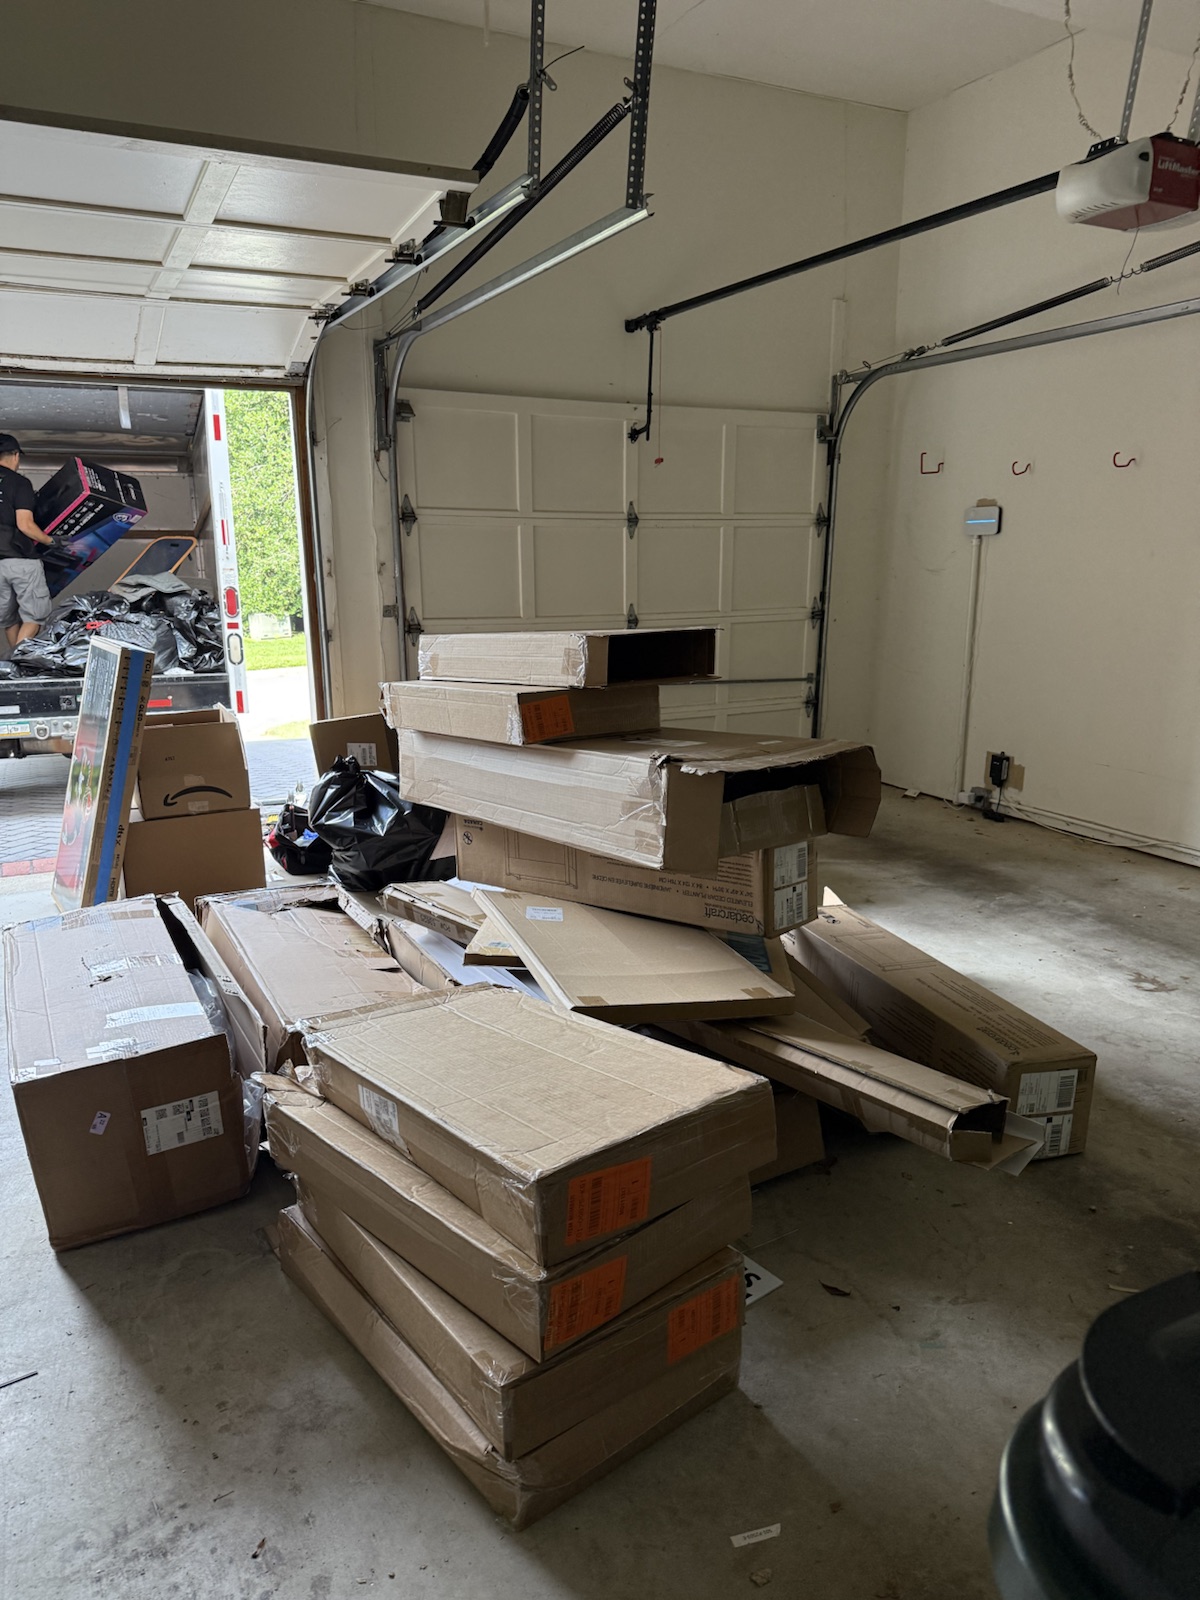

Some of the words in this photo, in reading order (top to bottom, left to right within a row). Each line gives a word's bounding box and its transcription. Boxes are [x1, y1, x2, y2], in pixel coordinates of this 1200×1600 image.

[144, 658, 152, 674] TCL
[682, 889, 708, 899] PLANTER
[707, 893, 726, 902] CEDAR
[704, 906, 755, 924] cedarcraft
